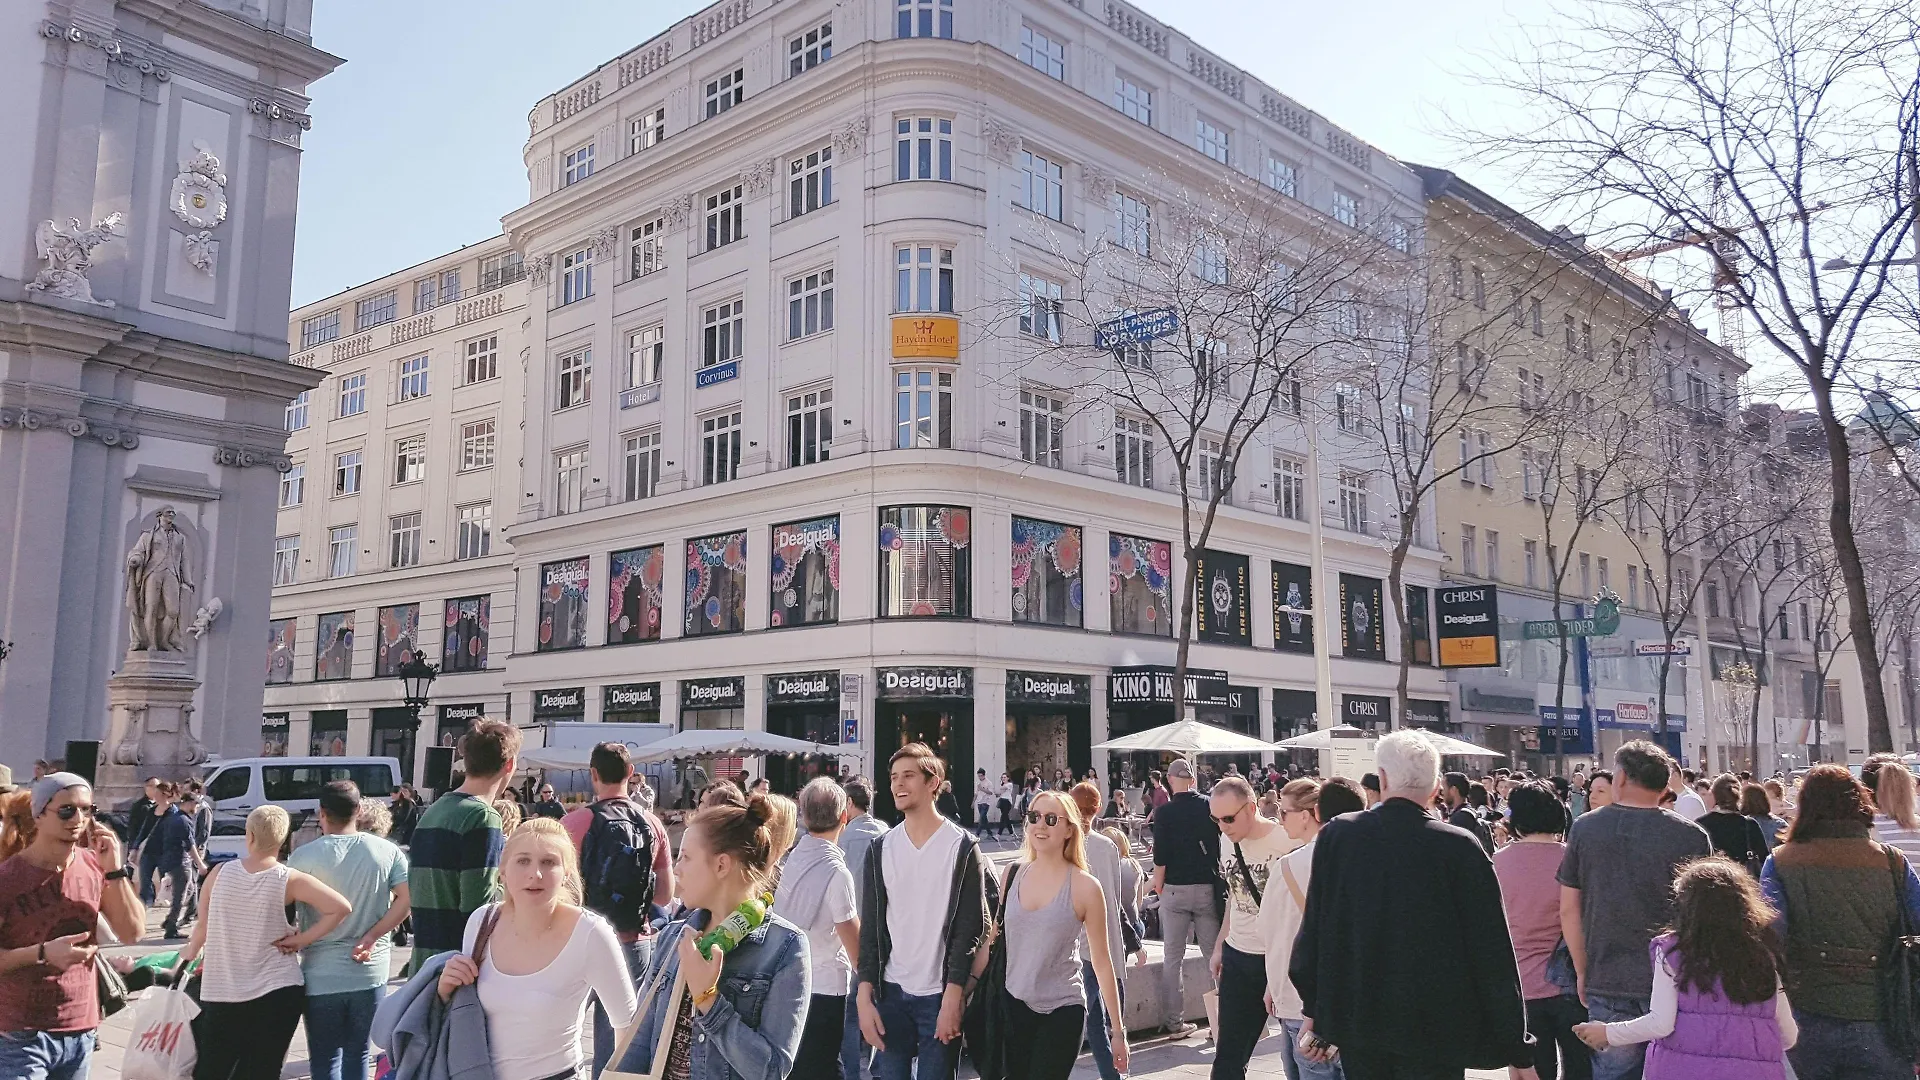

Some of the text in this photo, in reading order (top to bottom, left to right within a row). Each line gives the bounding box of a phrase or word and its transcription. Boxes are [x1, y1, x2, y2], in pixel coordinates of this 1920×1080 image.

[896, 335, 926, 345] Haydn
[700, 368, 734, 385] Corvinus
[628, 389, 650, 406] Hotel
[1197, 559, 1205, 631] BREITLING
[1237, 566, 1246, 636] BREITLING
[1442, 589, 1486, 604] CHRIST
[1272, 571, 1280, 640] BREITLING
[1340, 583, 1348, 648] BREITLING
[1373, 588, 1381, 651] BREITLING
[1112, 676, 1197, 700] KINO HADN
[1349, 700, 1378, 716] CHRIST
[1619, 703, 1647, 720] Hartlauer
[1548, 728, 1579, 737] FRSEUR
[135, 1020, 184, 1056] H&M
